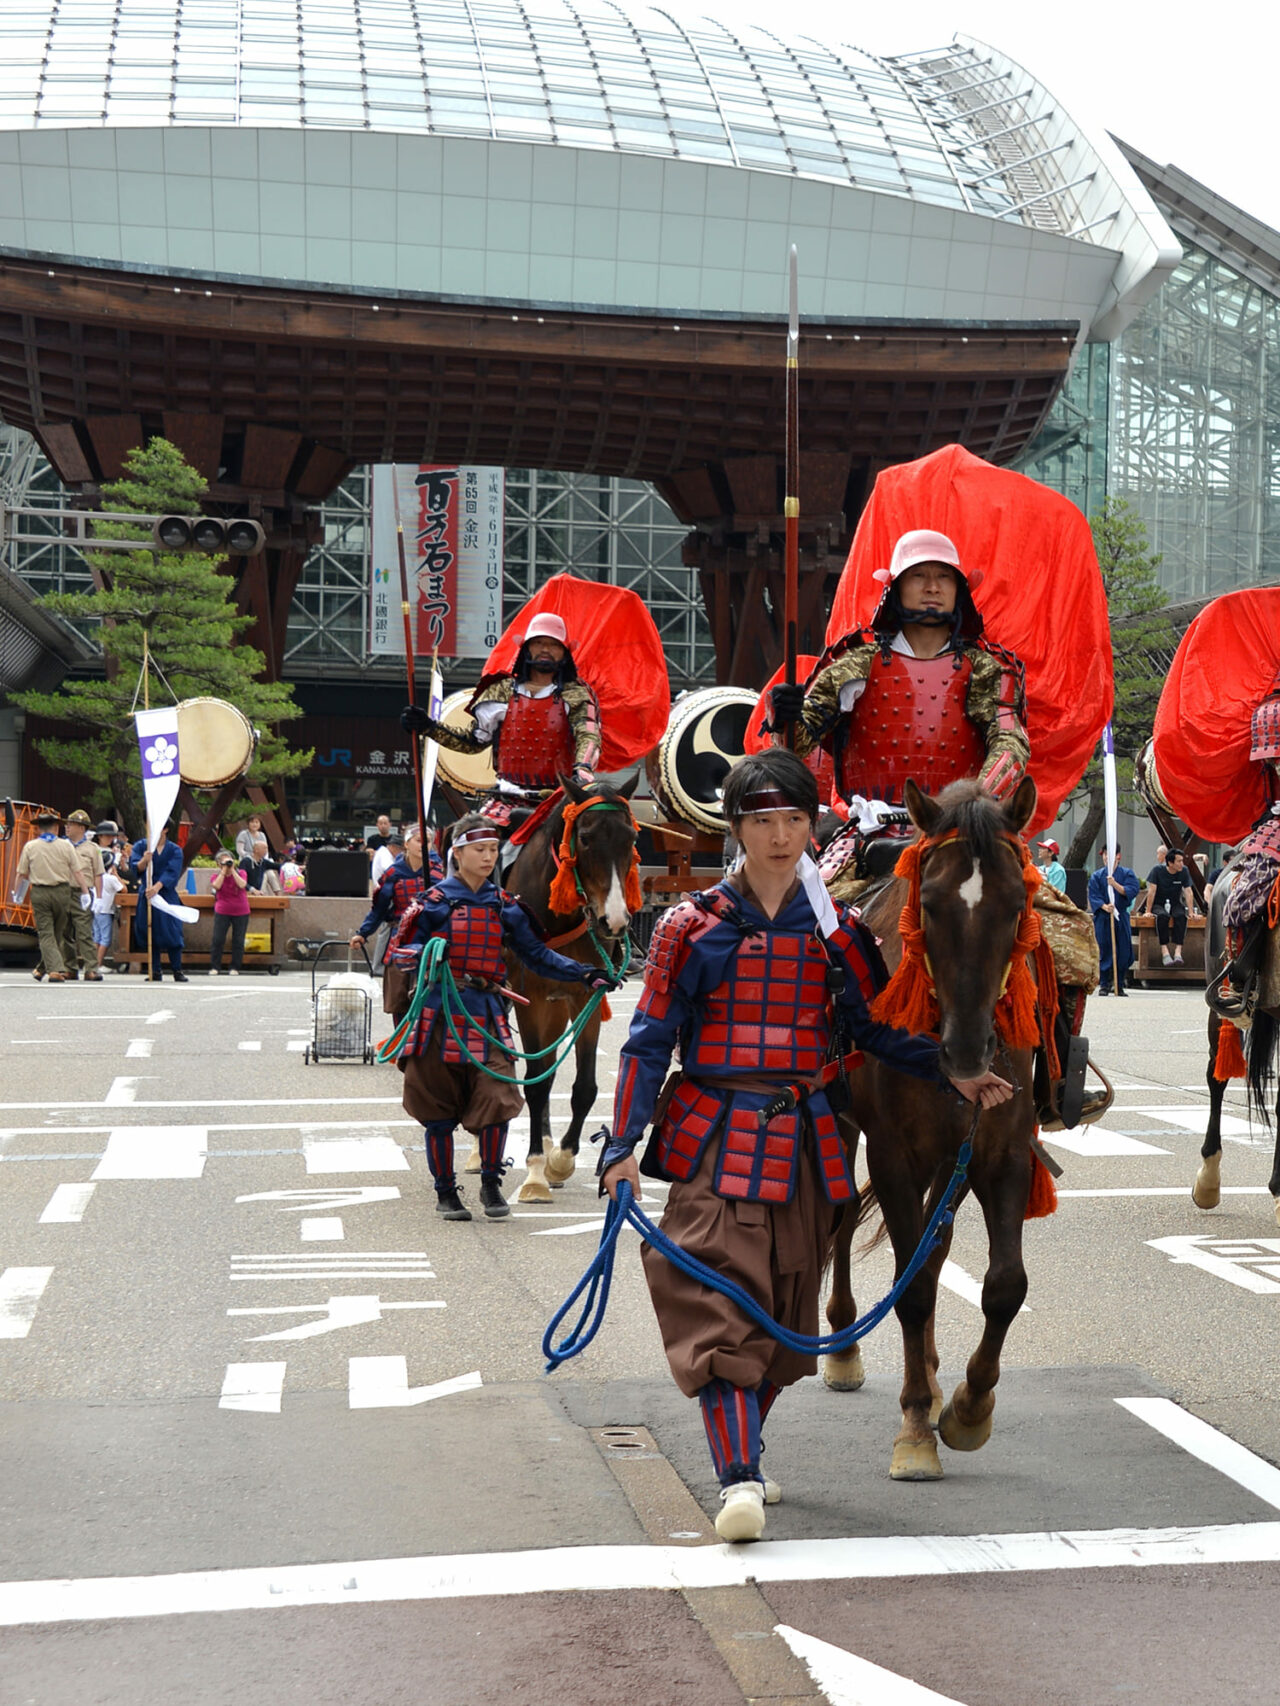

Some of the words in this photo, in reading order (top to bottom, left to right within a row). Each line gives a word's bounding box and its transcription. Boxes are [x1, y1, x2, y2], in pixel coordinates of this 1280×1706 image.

[415, 469, 460, 648] 百万石まつり
[318, 748, 352, 767] JR
[369, 750, 410, 765] 金沢
[356, 766, 408, 775] KANAZAWA
